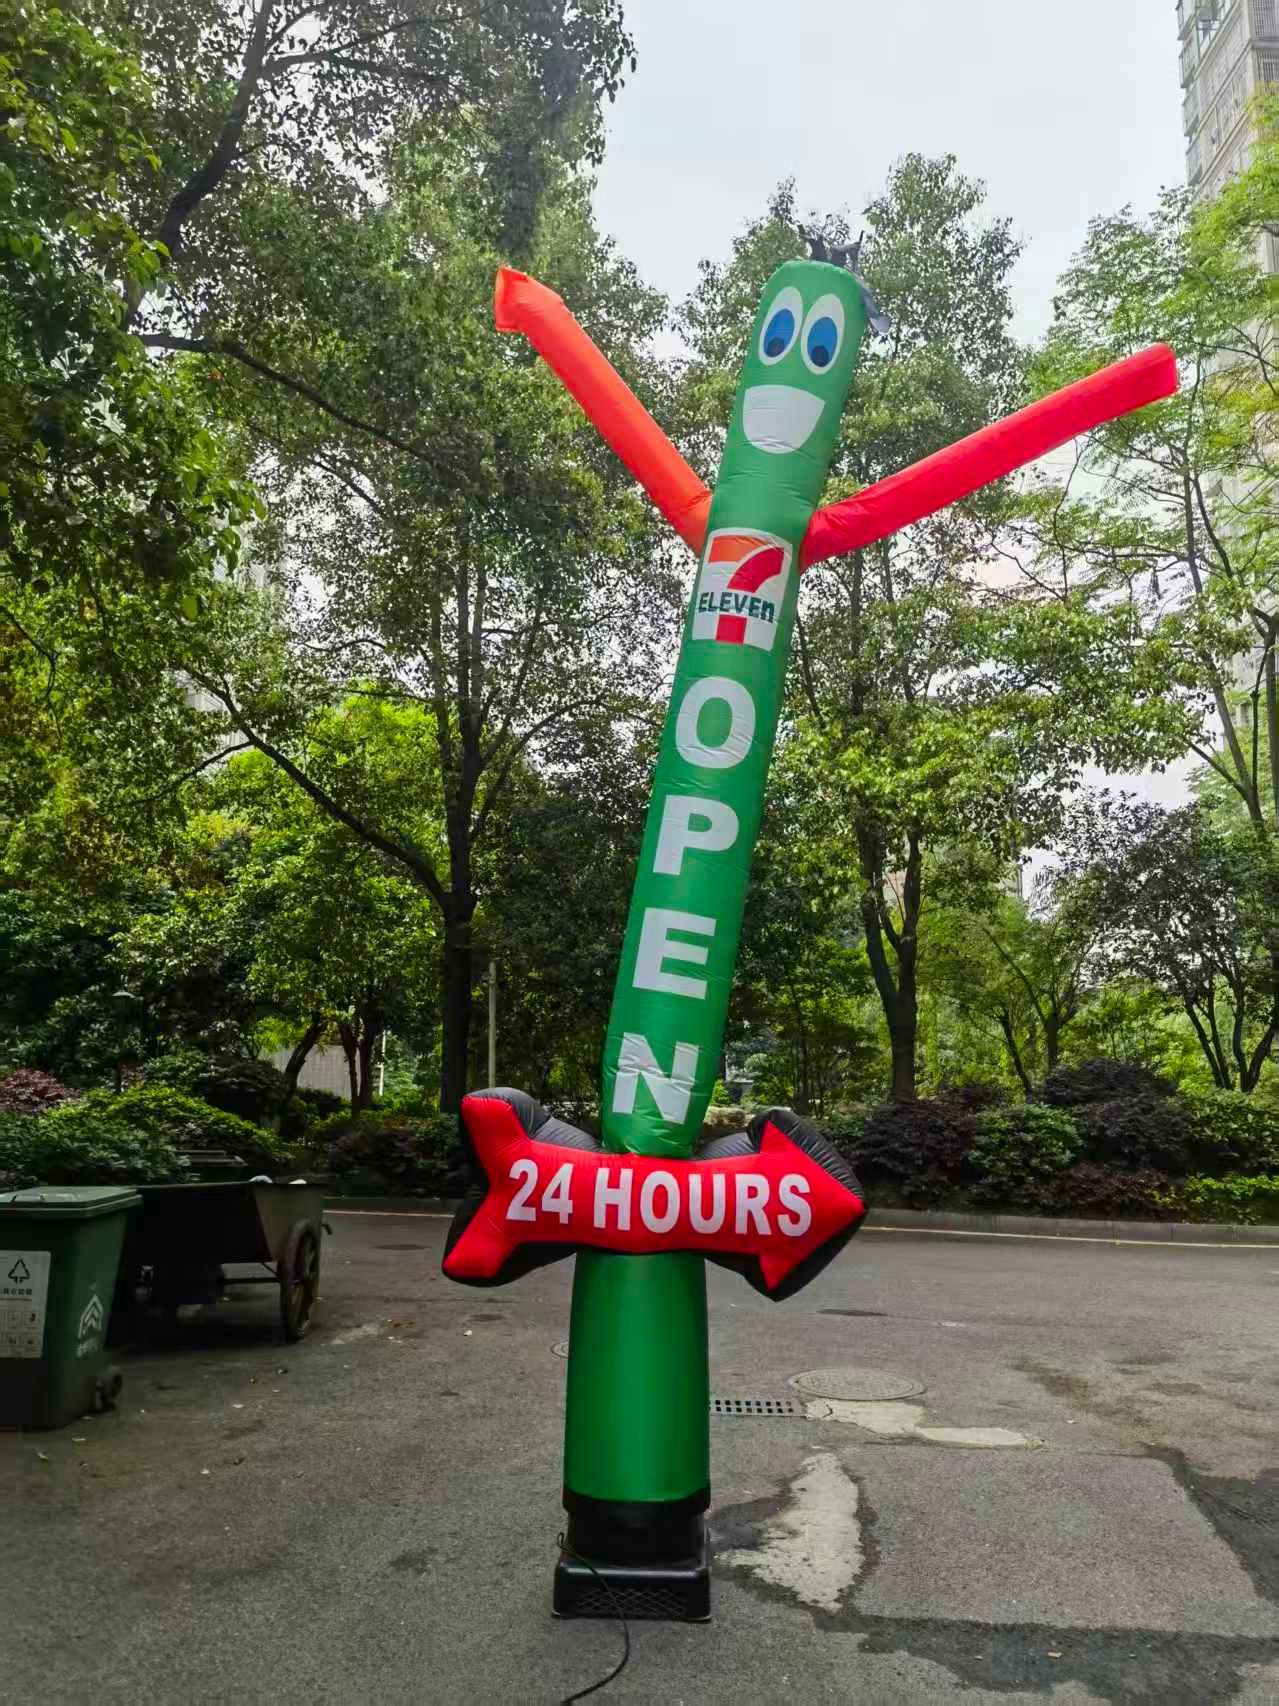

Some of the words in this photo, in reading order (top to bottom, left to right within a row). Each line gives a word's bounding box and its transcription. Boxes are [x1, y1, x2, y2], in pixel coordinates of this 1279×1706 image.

[708, 534, 784, 645] 7
[612, 676, 756, 1124] OPEN
[506, 1159, 574, 1224] 24
[593, 1167, 812, 1237] HOURS
